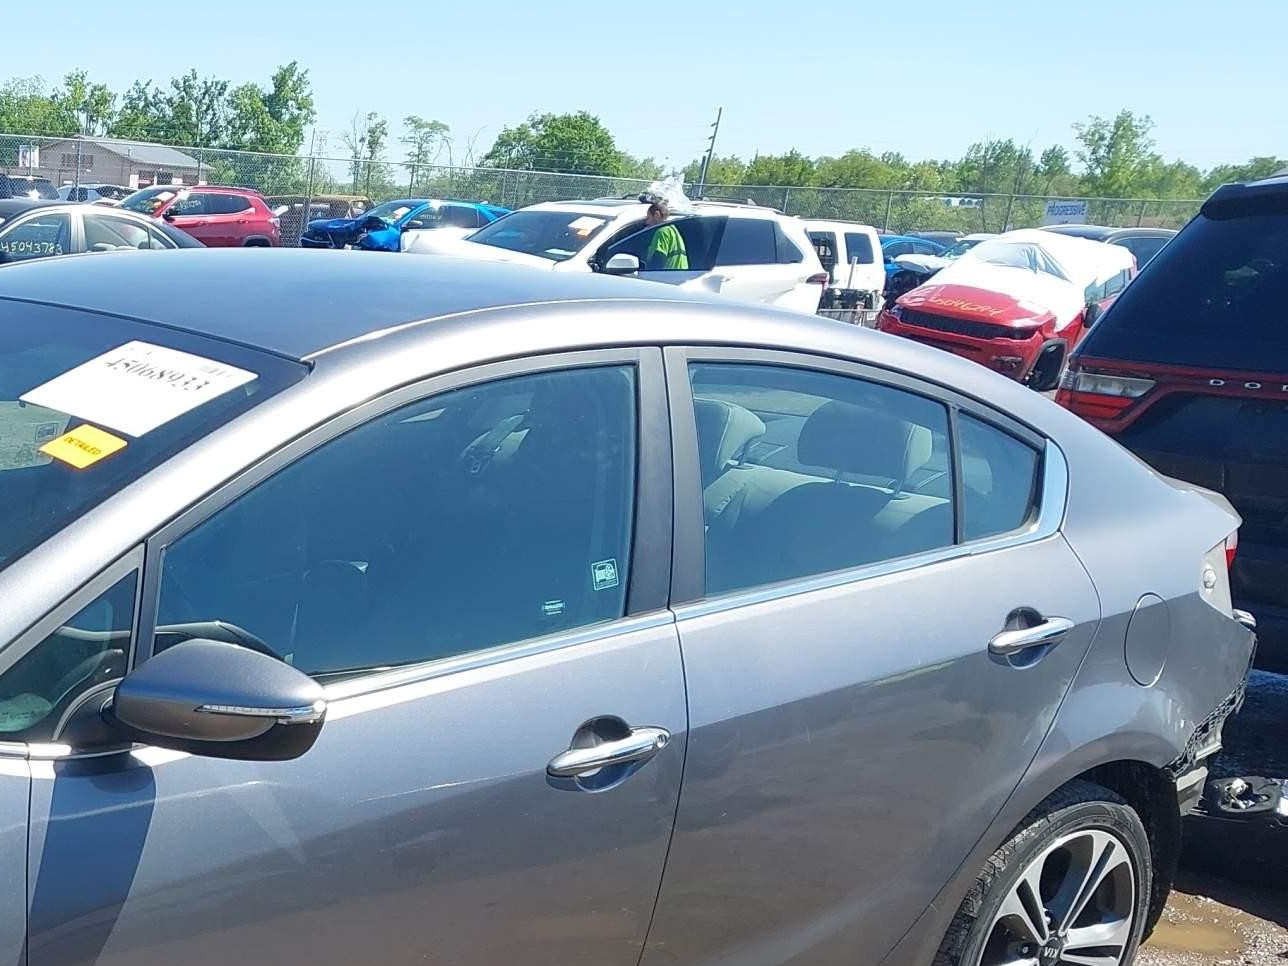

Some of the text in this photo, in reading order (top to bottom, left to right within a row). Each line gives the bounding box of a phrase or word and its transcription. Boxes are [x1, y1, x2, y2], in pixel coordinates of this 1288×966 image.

[1046, 201, 1086, 216] PROGRESSIVE
[0, 241, 63, 255] 45043783
[105, 358, 210, 391] 45068933
[63, 436, 102, 455] DETAILED
[1043, 946, 1060, 959] KIA
